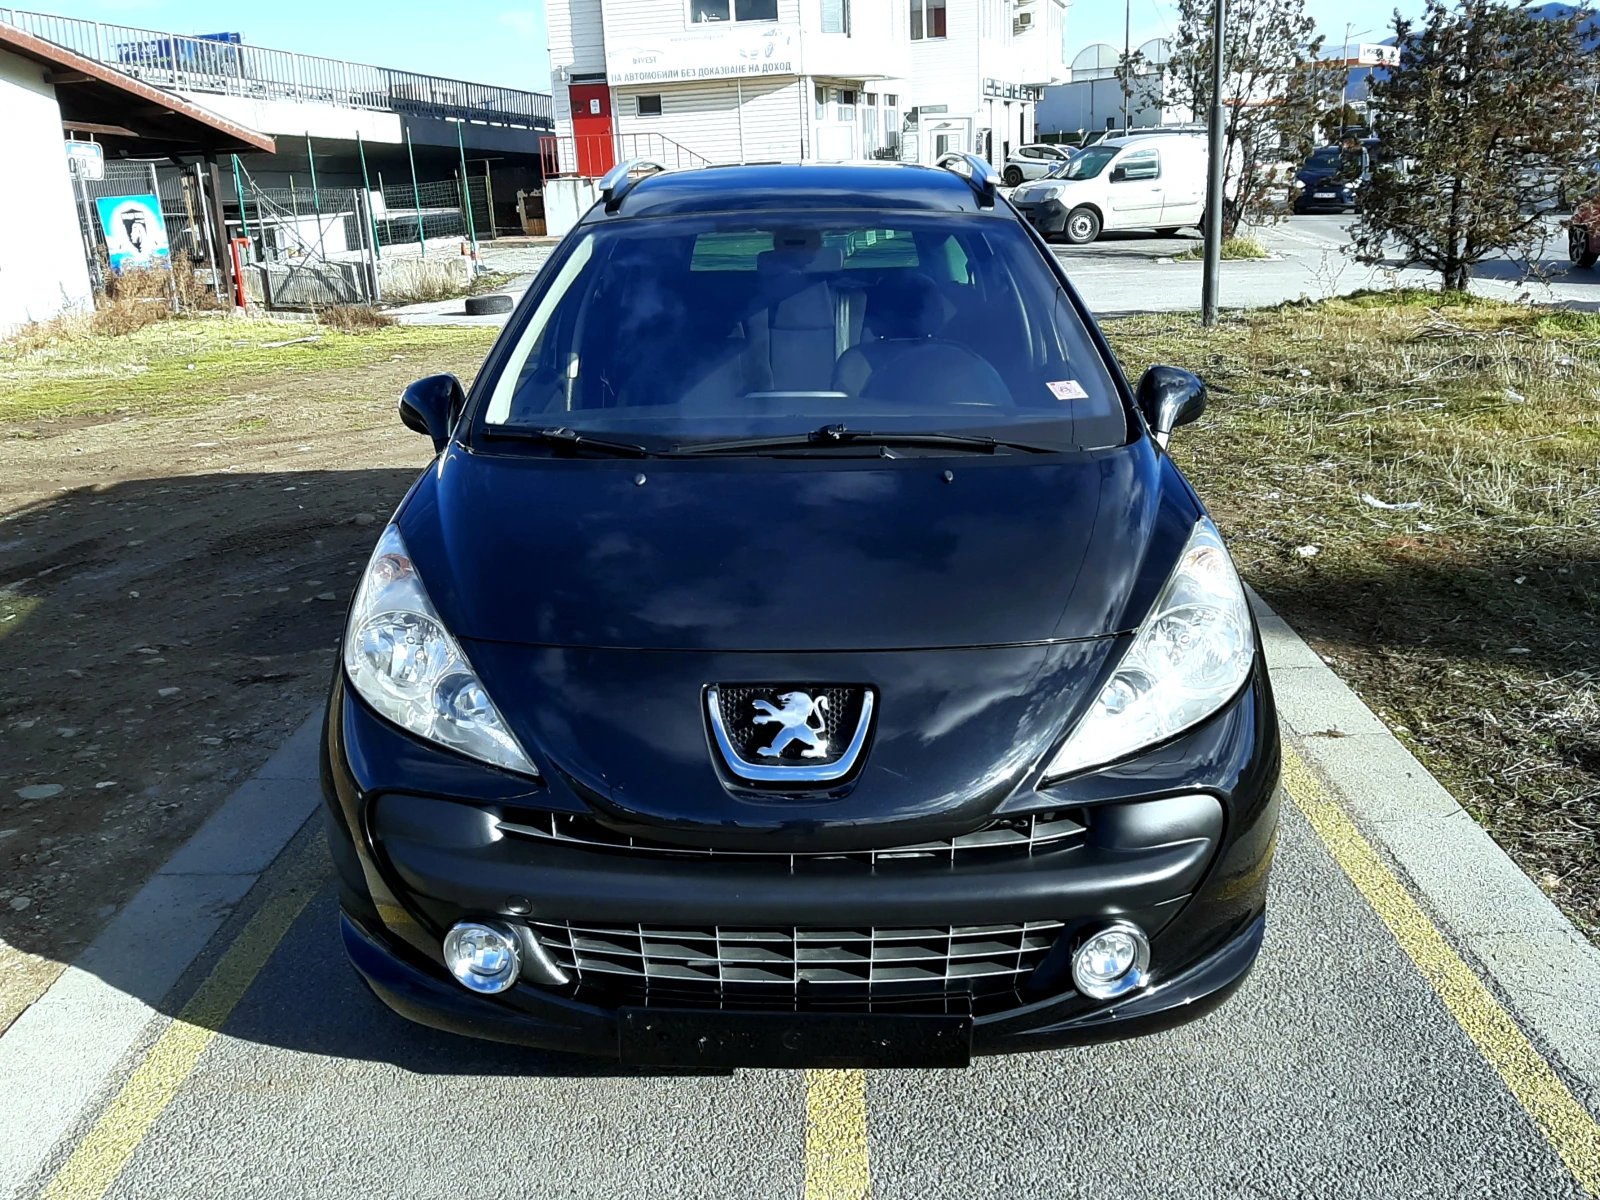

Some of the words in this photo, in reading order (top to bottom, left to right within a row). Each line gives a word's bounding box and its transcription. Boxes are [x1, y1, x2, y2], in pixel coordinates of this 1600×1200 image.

[611, 73, 622, 82] НА
[624, 69, 679, 81] АВТОМОБИЛИ
[681, 68, 696, 77] БЕЗ
[698, 64, 746, 76] ДОКАЗВАНЕ
[748, 64, 760, 73] НА
[762, 61, 792, 73] ДОХОД
